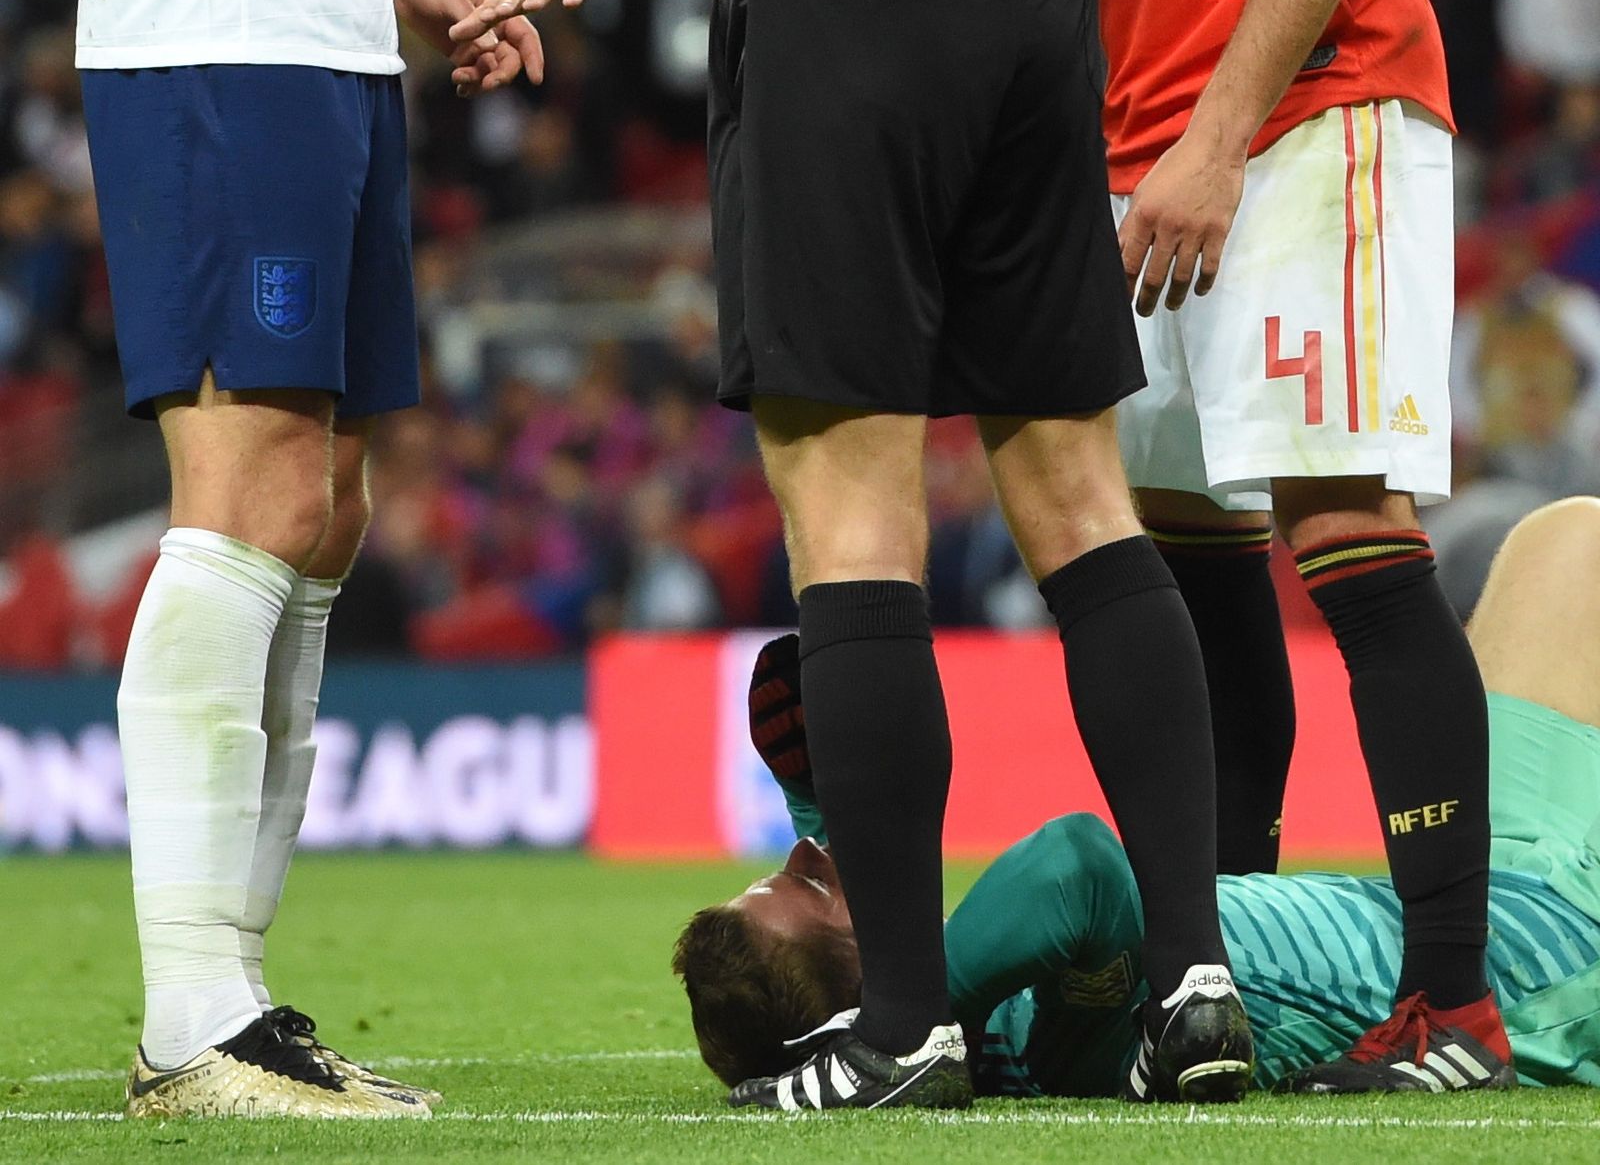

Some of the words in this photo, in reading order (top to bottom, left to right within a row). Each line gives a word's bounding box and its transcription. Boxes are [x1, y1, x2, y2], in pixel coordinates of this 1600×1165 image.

[1264, 315, 1323, 425] 4
[1389, 418, 1429, 436] adidas
[1187, 973, 1233, 989] adida
